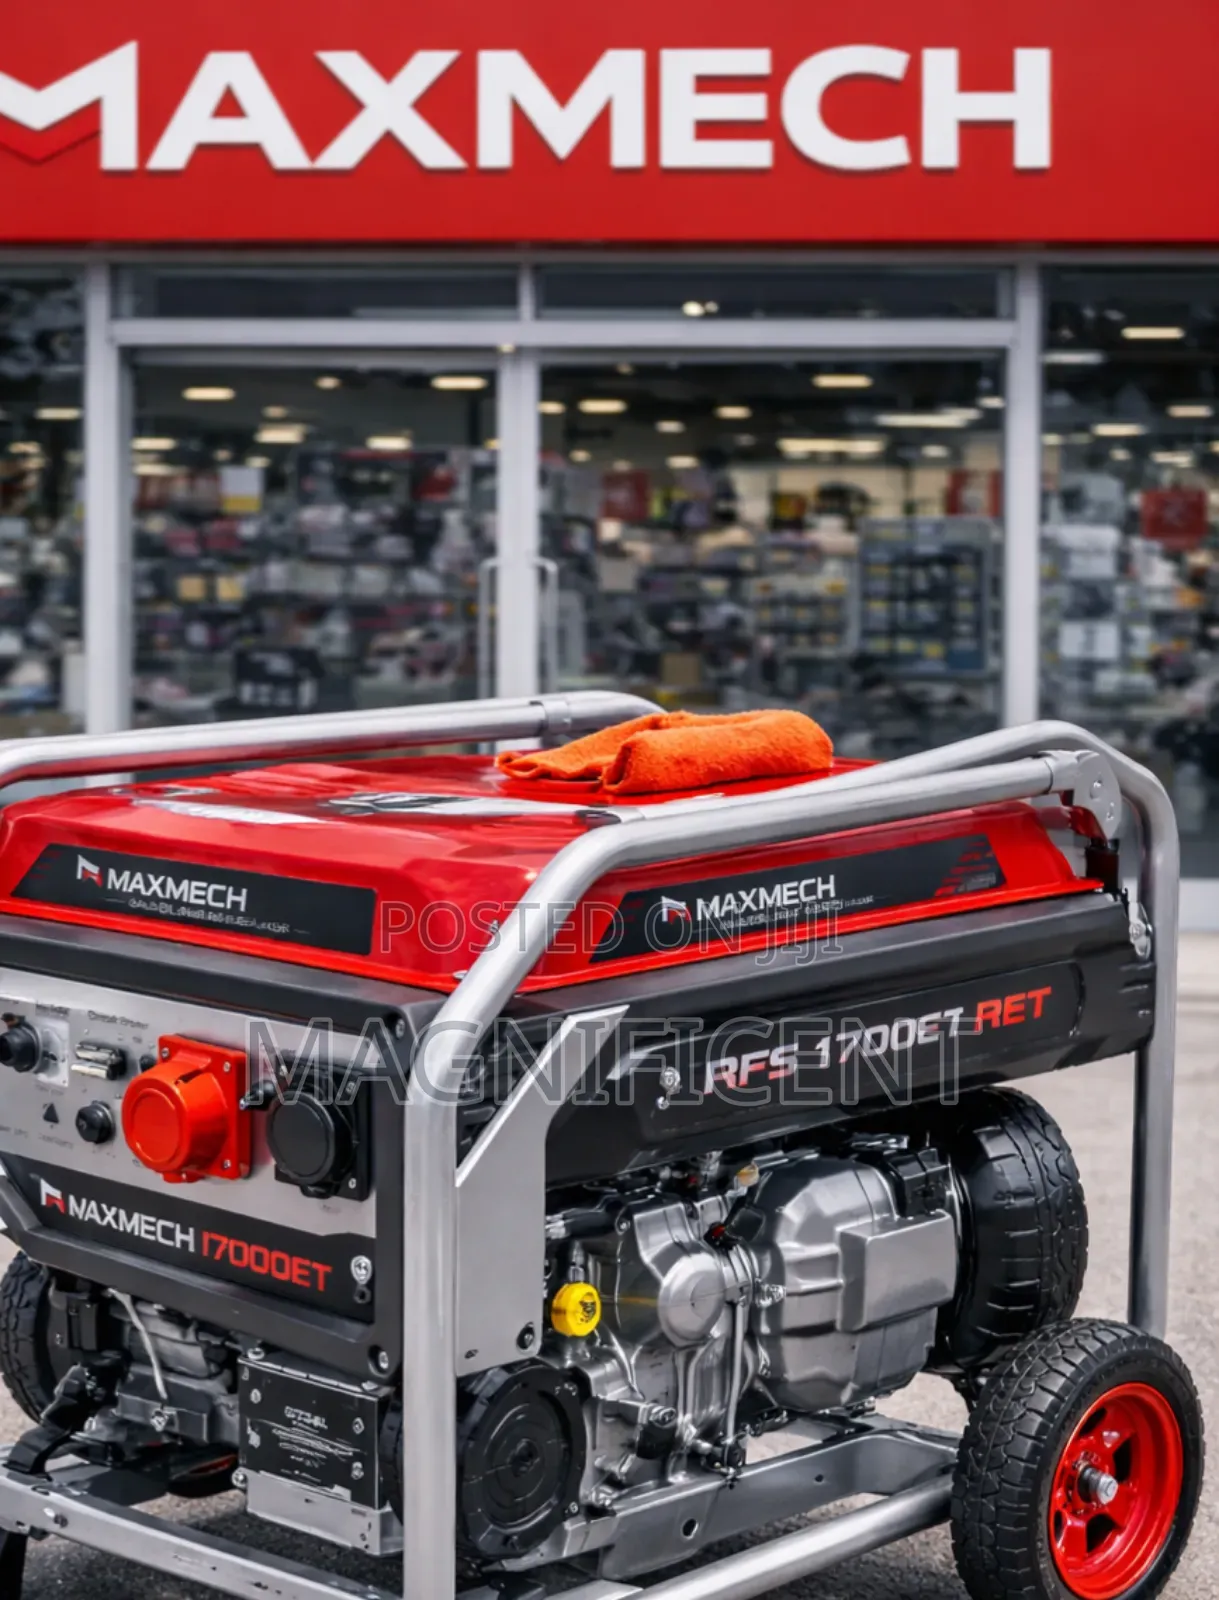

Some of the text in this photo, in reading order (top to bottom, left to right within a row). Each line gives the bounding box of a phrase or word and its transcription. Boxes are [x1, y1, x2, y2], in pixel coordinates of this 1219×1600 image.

[0, 40, 1052, 171] MAXMECH
[106, 868, 248, 912] MAXMECH
[696, 874, 837, 921] MAXMECH
[703, 1042, 799, 1095] RFS
[973, 986, 1053, 1033] RET
